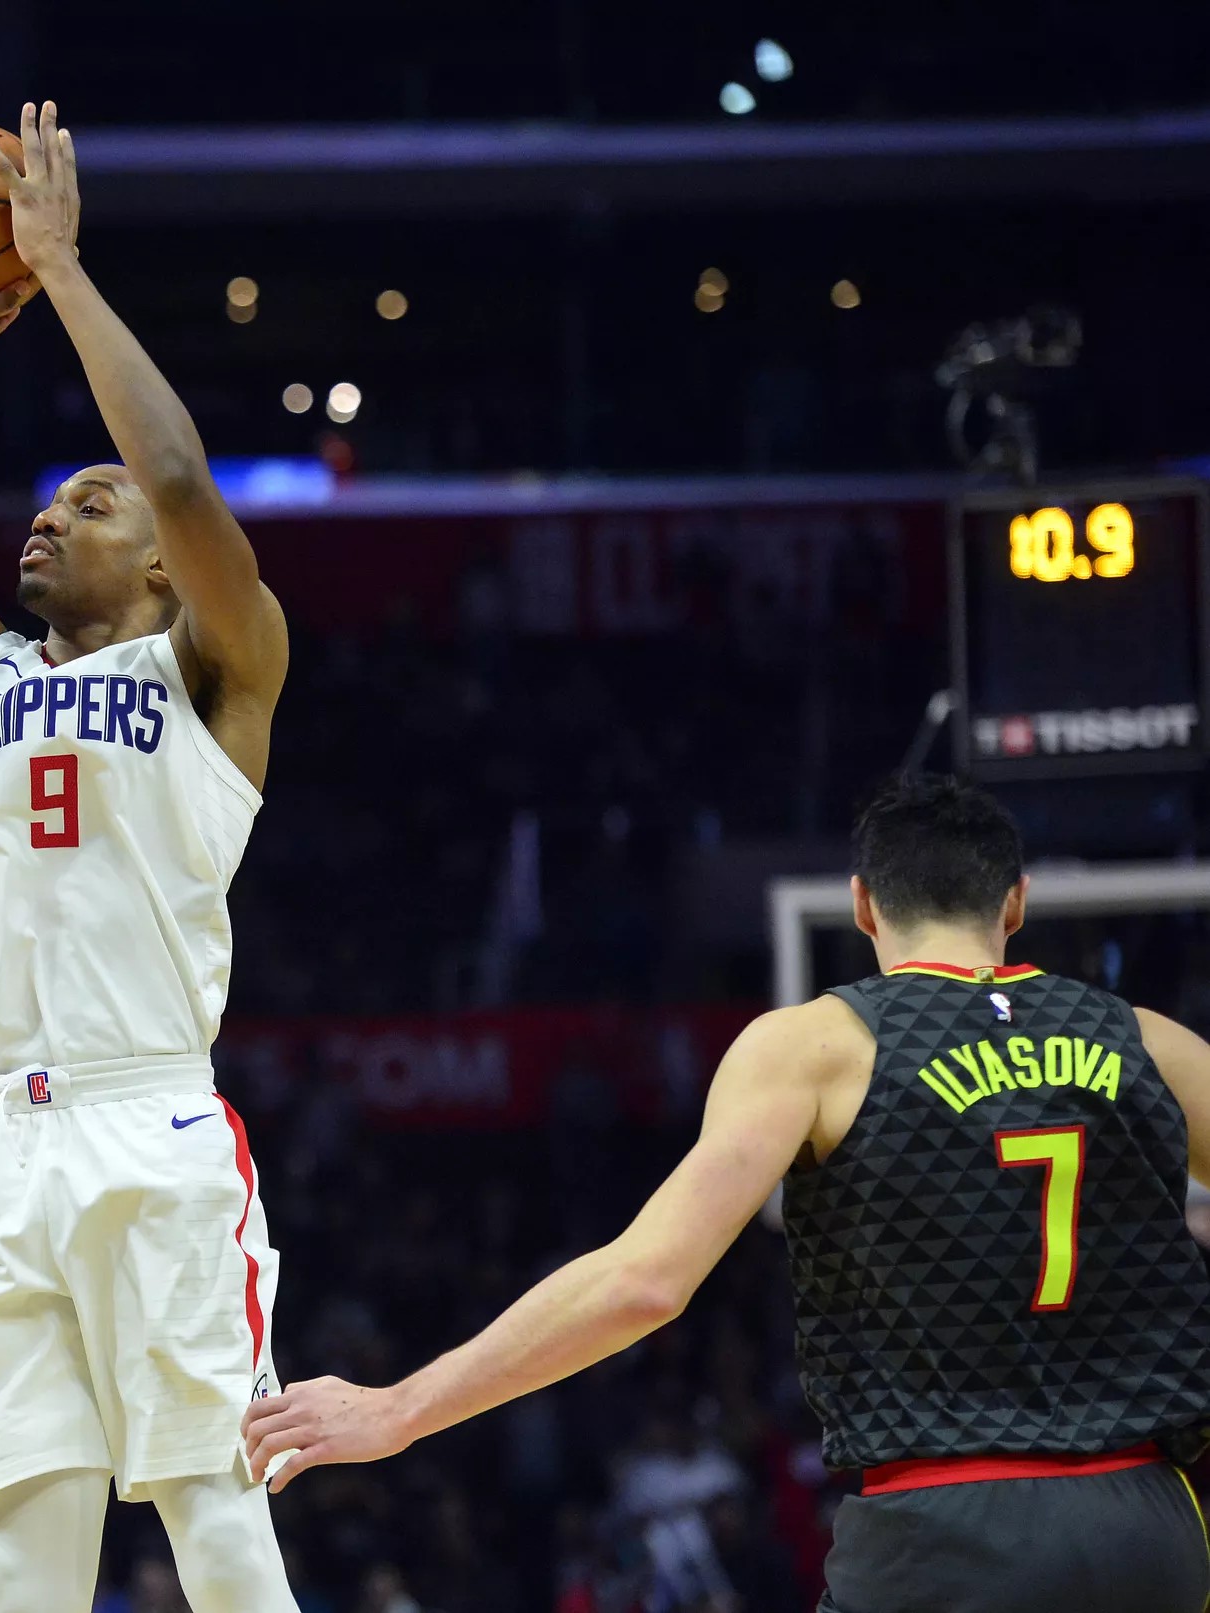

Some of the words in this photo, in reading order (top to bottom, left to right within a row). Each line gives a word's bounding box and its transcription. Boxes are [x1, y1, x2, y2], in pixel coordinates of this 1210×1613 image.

[1036, 703, 1198, 755] TISSOT
[30, 754, 79, 849] 9
[918, 1036, 1122, 1115] ILYASOVA
[994, 1124, 1086, 1312] 7
